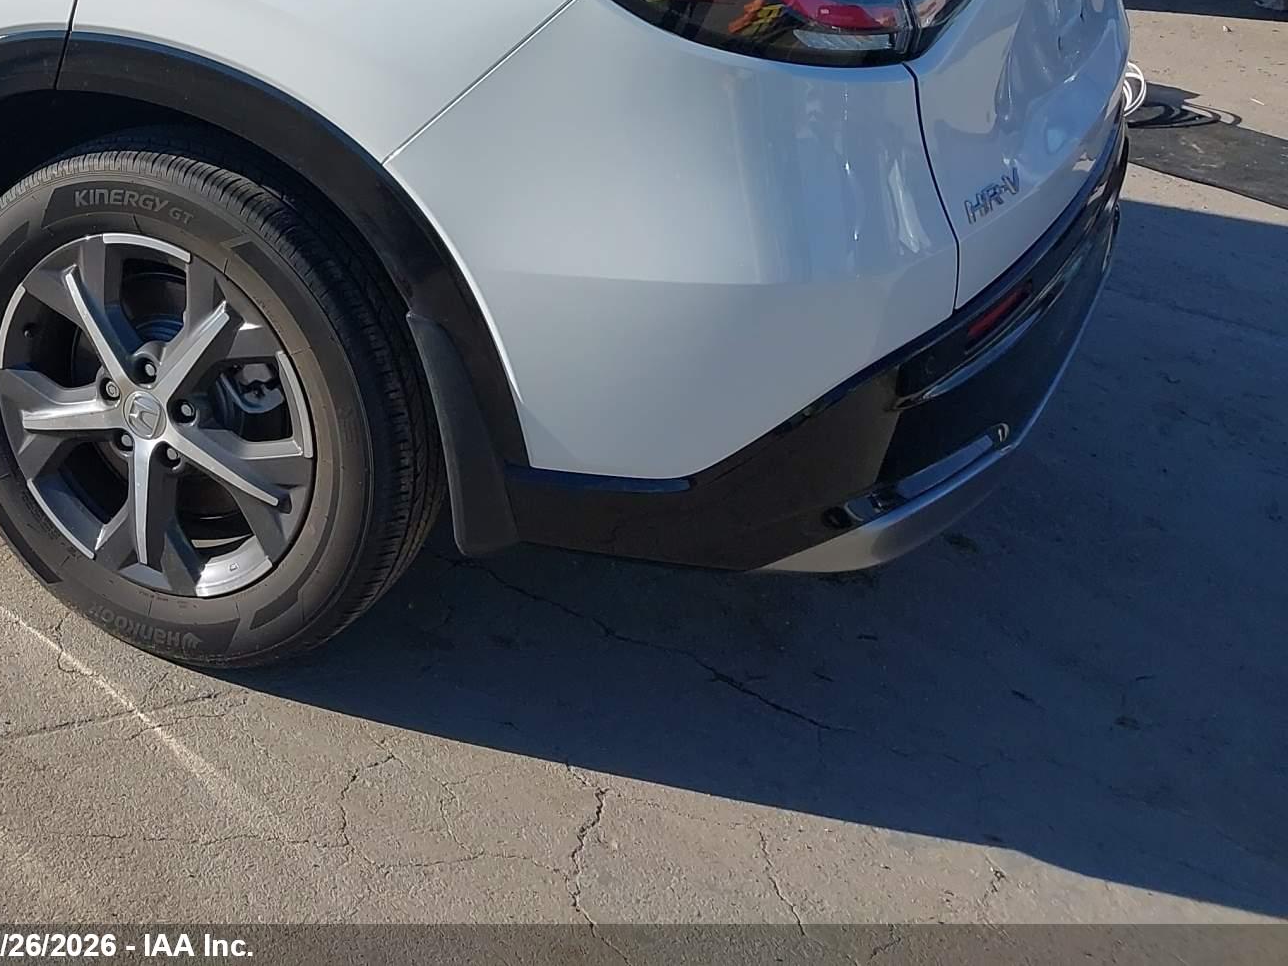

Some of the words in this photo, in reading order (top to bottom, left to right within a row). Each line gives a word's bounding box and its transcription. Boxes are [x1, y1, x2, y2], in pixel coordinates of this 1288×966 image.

[74, 188, 169, 212] KINERGY
[169, 206, 194, 224] GT
[964, 167, 1020, 224] HR-V
